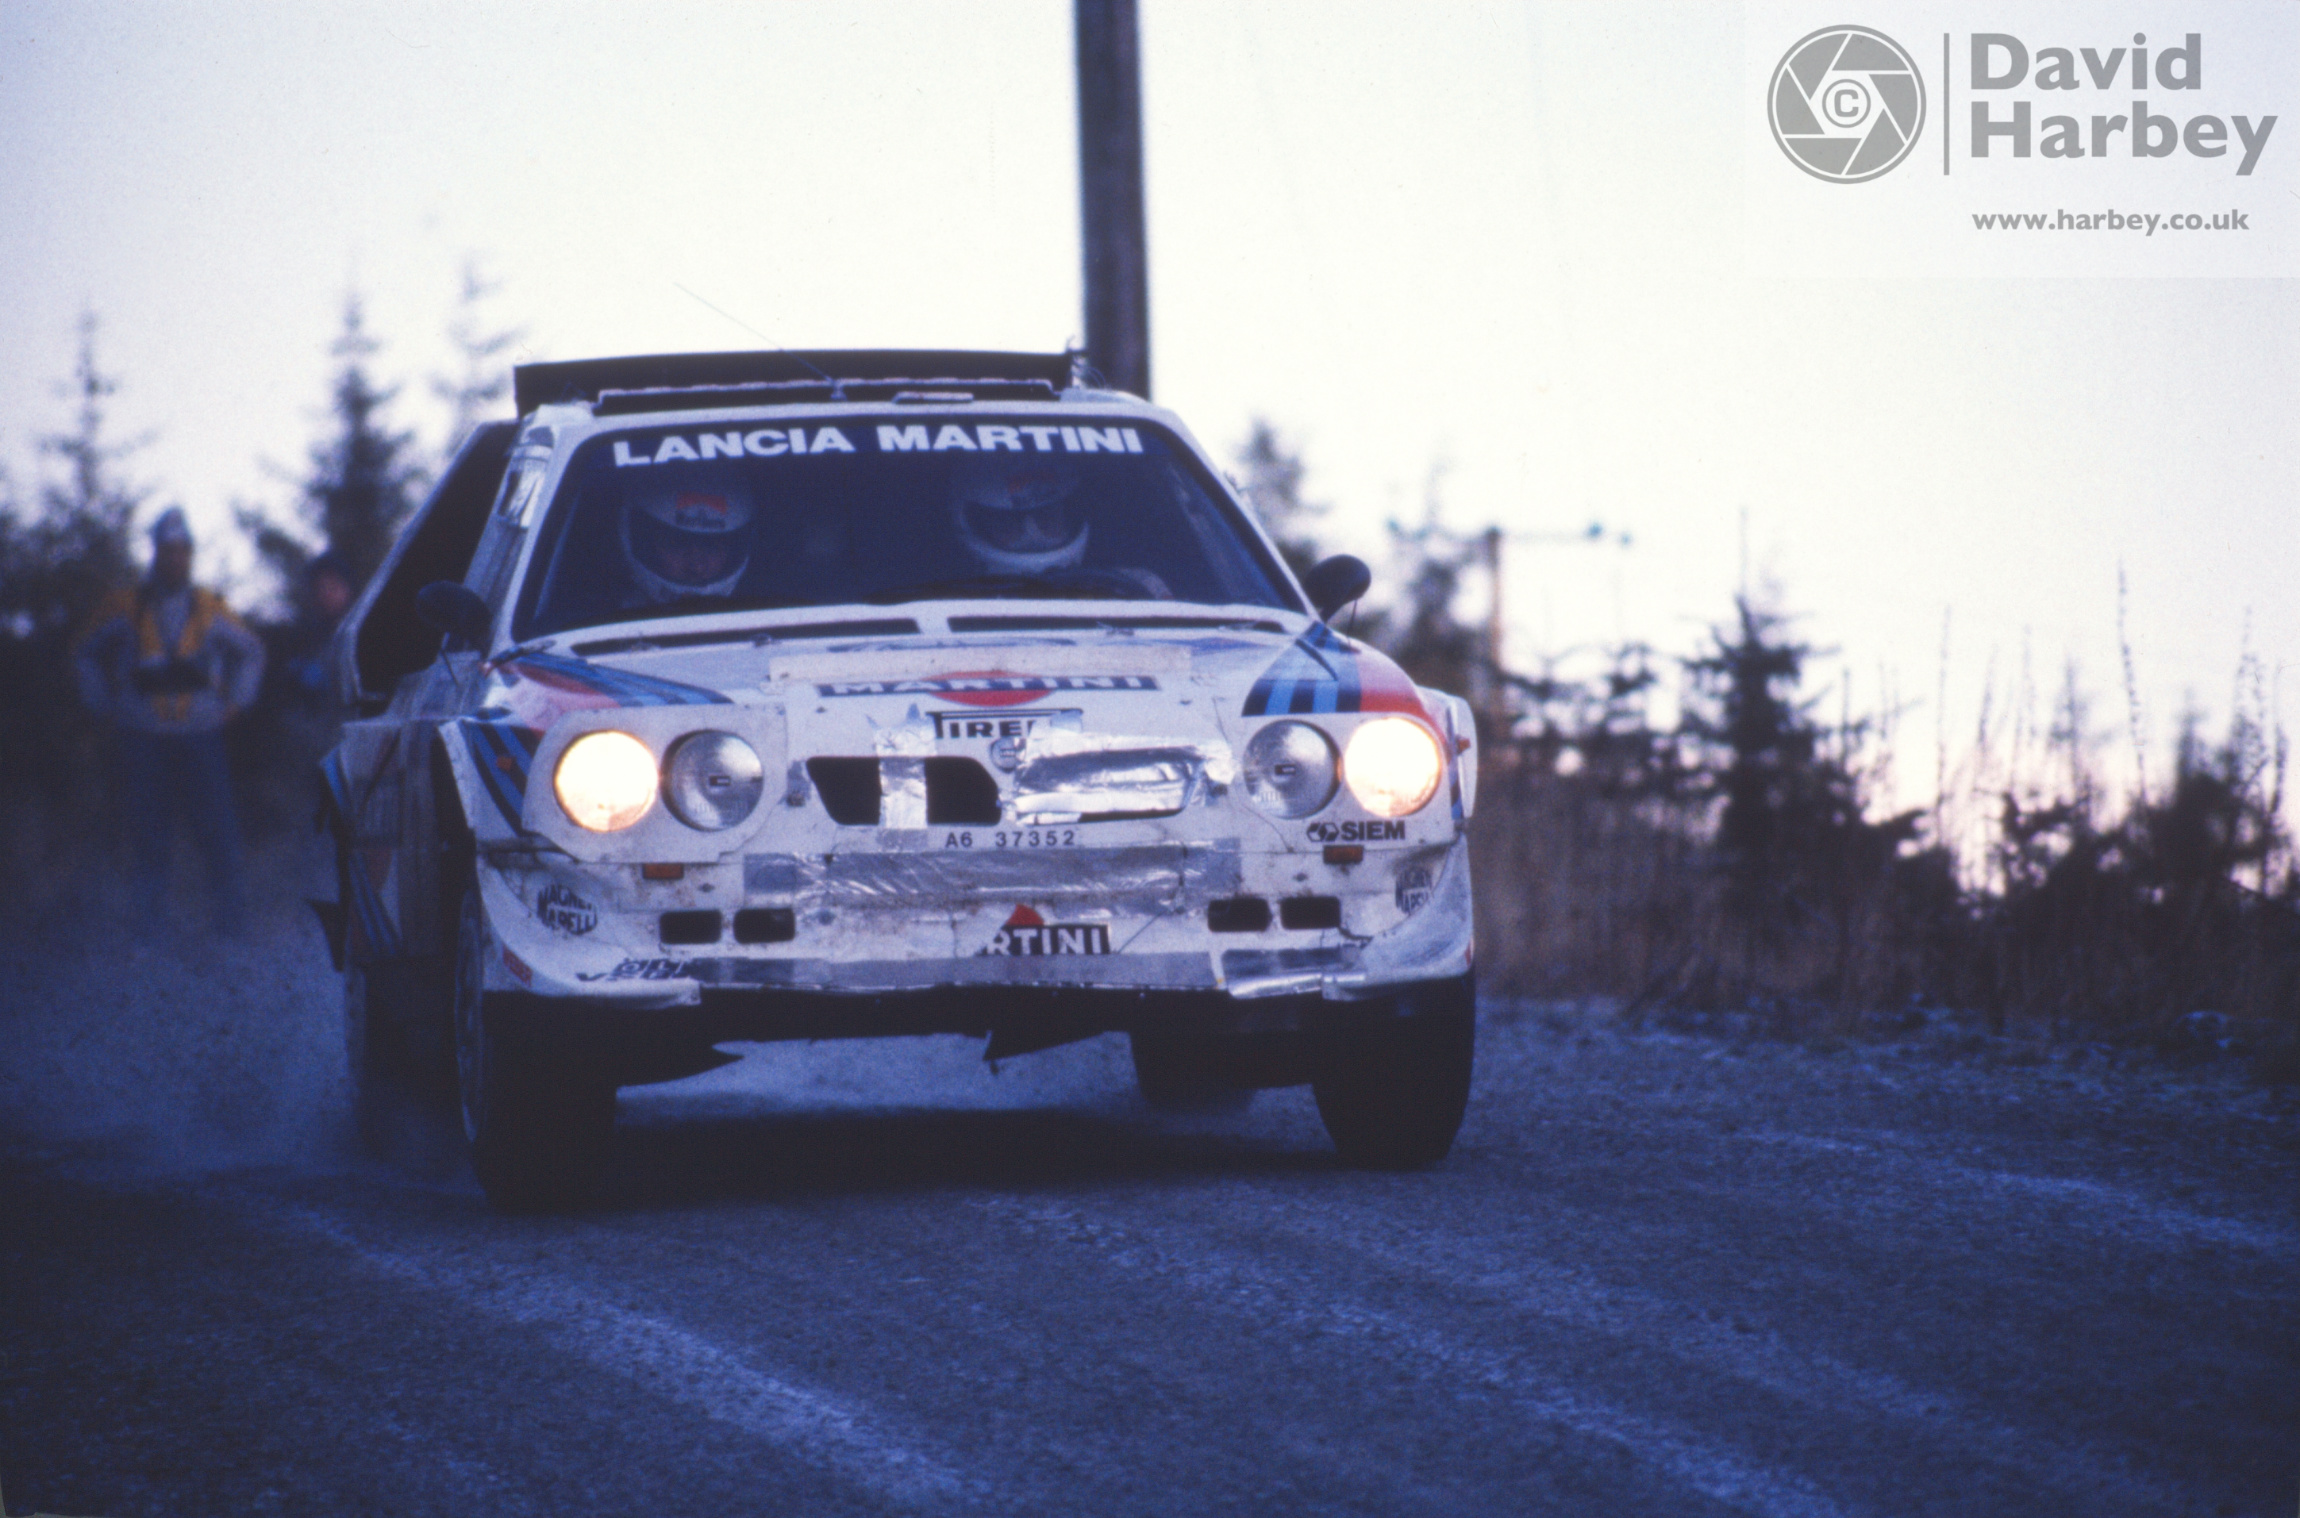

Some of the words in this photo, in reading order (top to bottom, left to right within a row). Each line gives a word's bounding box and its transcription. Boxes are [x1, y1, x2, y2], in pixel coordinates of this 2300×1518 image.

[612, 426, 855, 468] LANCIA
[876, 424, 1144, 454] MARTINI
[831, 676, 1144, 694] MARTINI
[945, 831, 974, 848] A6
[994, 830, 1076, 848] 37352
[1340, 820, 1406, 842] SIEM
